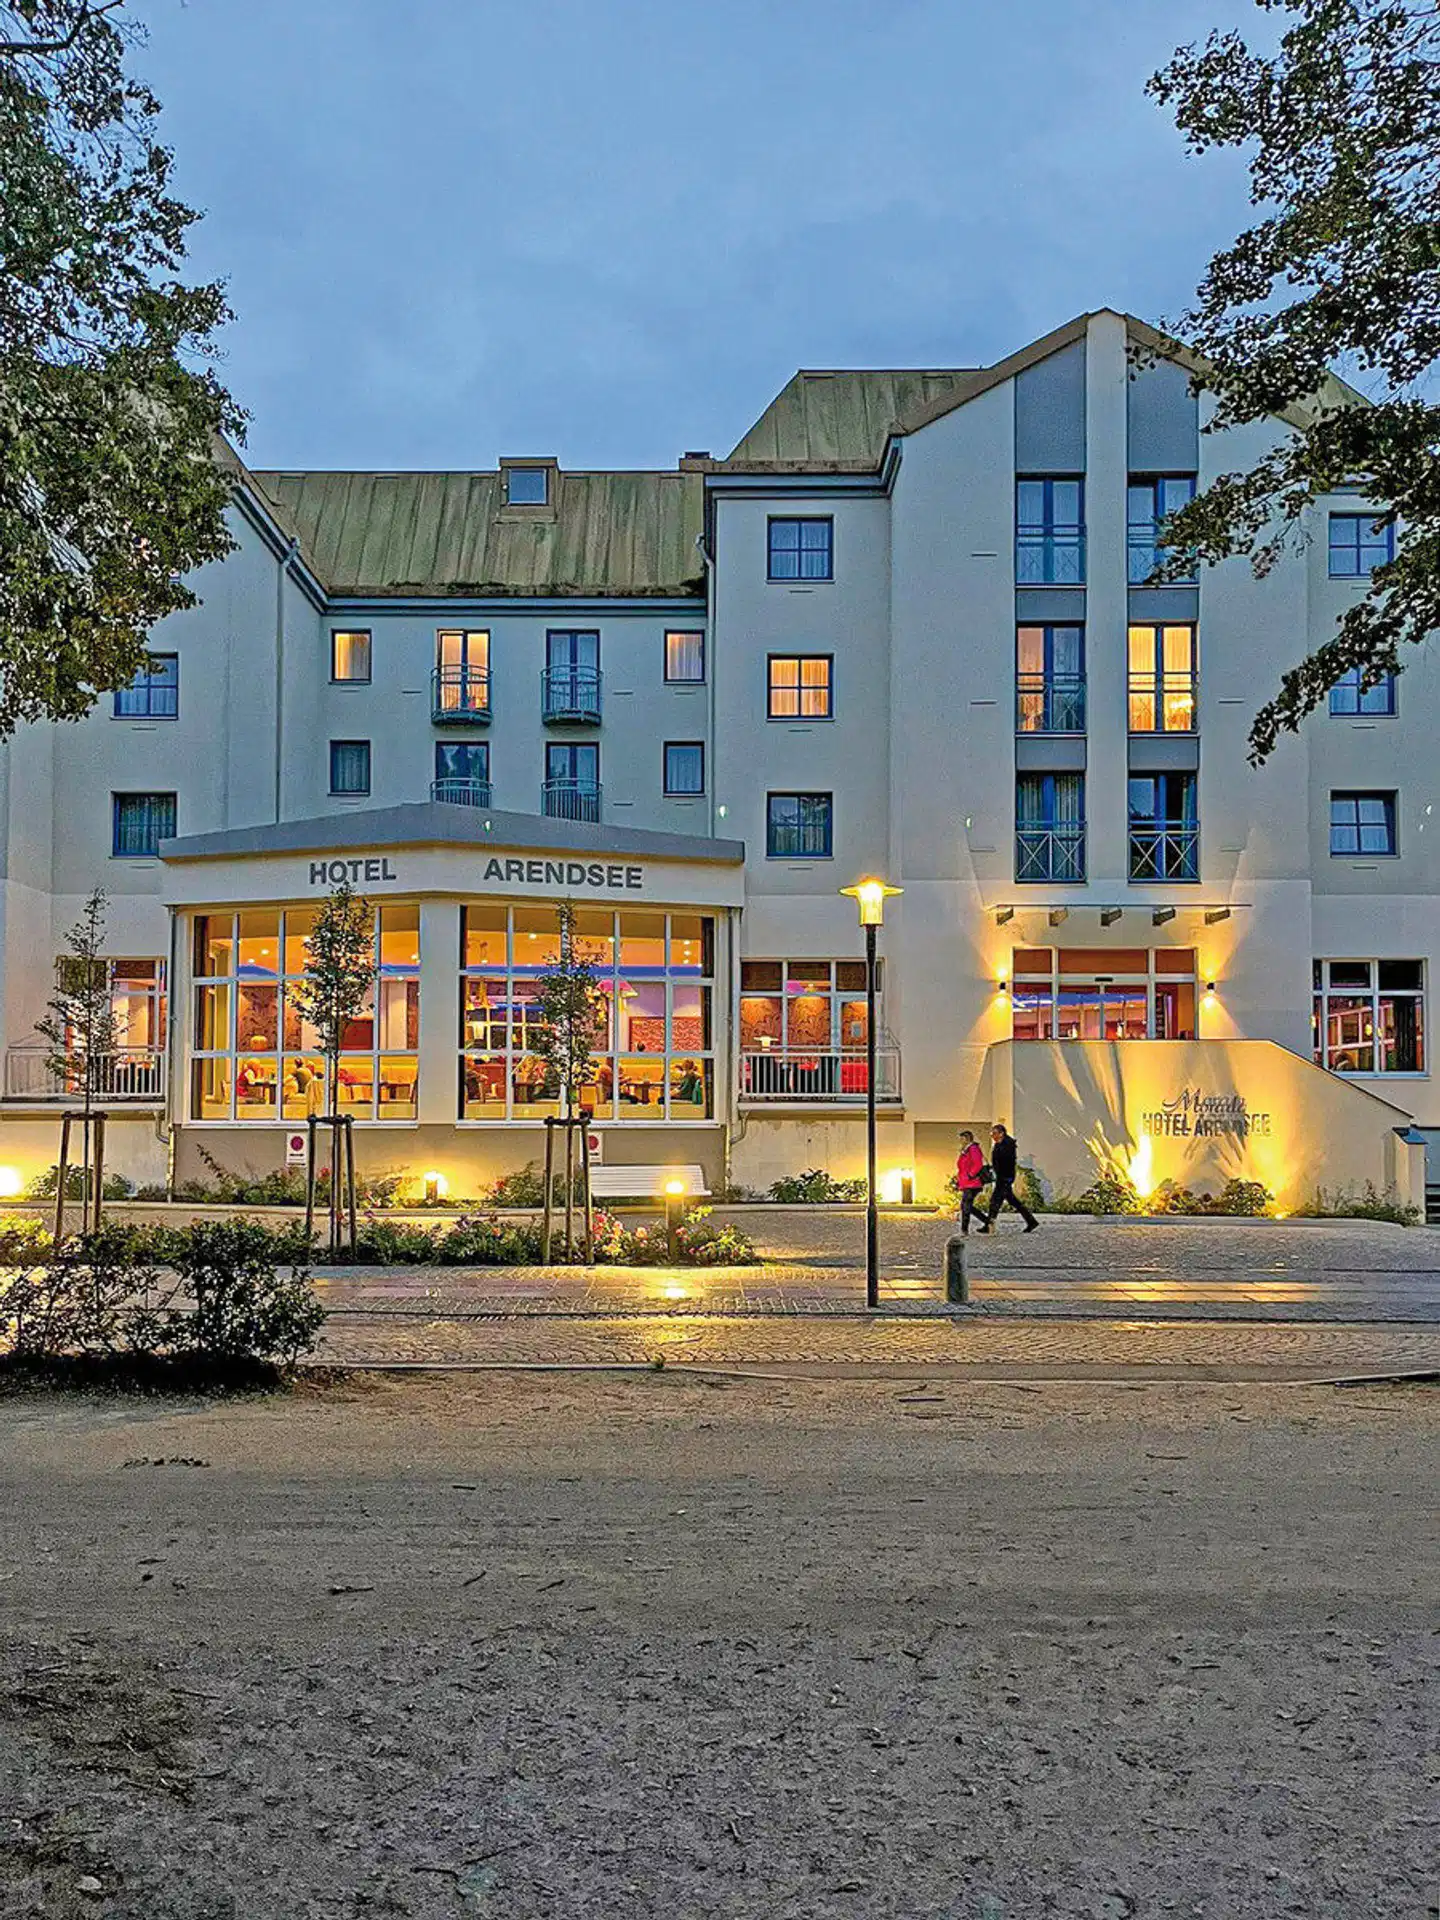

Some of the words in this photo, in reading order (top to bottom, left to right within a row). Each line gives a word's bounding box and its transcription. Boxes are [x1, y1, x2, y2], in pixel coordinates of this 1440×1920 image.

[309, 858, 396, 884] HOTEL
[483, 859, 643, 888] ARENDSEE
[1142, 1112, 1192, 1136] HOTEL
